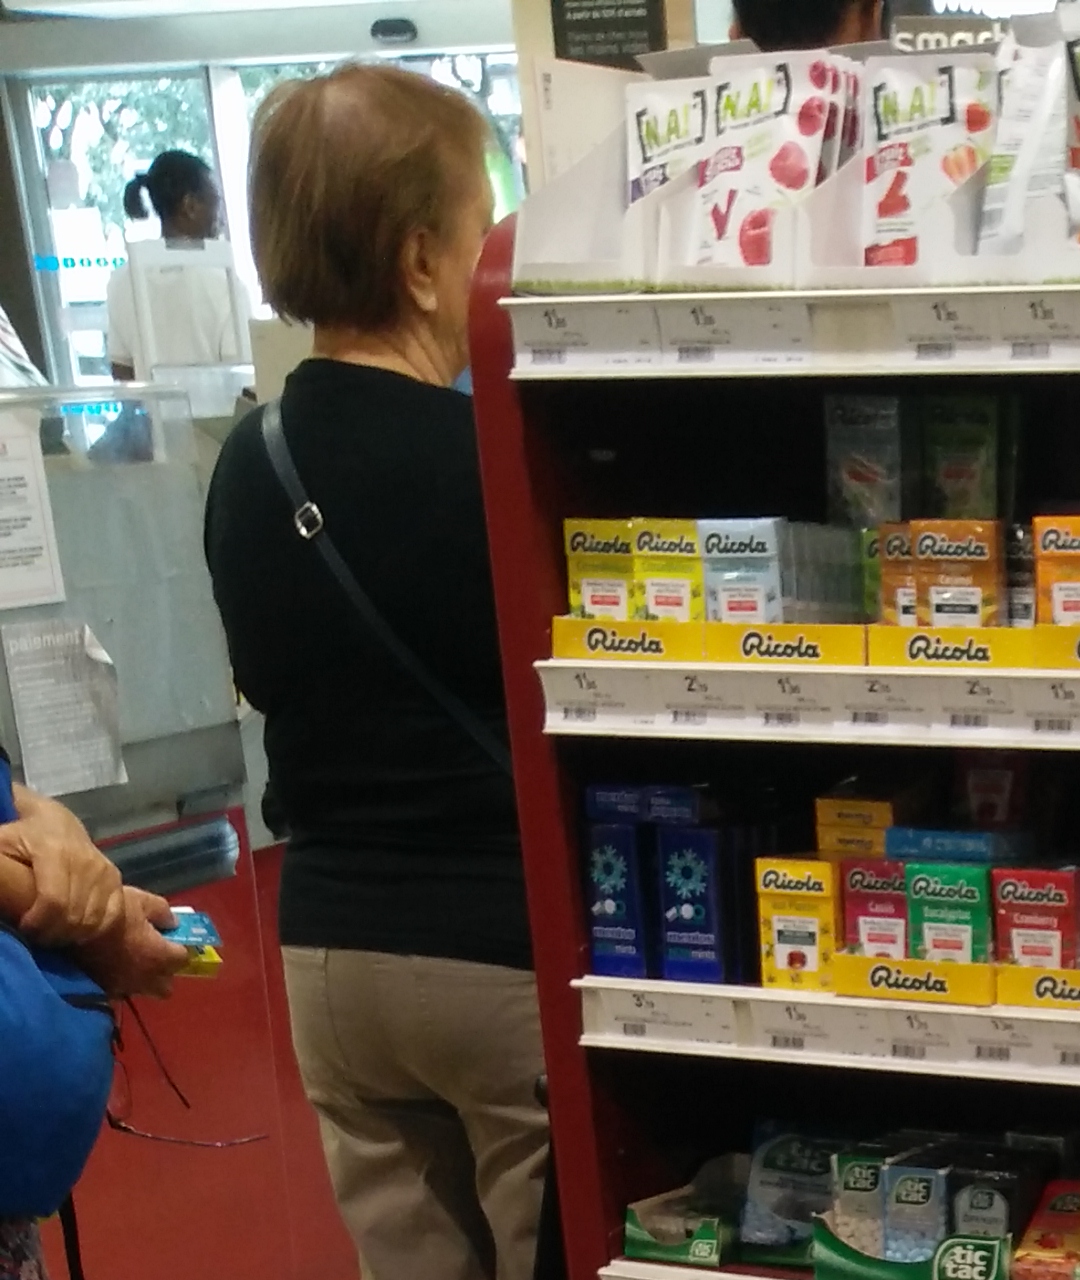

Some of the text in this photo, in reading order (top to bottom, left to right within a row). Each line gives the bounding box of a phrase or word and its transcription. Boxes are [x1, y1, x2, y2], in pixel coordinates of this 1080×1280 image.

[570, 531, 631, 553] Ricola
[637, 531, 696, 553] Ricola
[705, 533, 767, 554] Ricola
[917, 533, 988, 558] Ricola
[587, 627, 664, 655] Ricola
[742, 630, 821, 659] Ricola
[908, 635, 991, 663] Ricola
[761, 870, 824, 892] Ricola
[912, 877, 979, 900] Ricola
[1000, 881, 1067, 904] Ricola
[870, 965, 948, 993] Ricola
[852, 1163, 876, 1180] tic
[849, 1177, 876, 1191] tac
[903, 1177, 928, 1192] tic
[901, 1188, 928, 1203] tac
[950, 1244, 987, 1266] tic
[944, 1262, 987, 1280] tac
